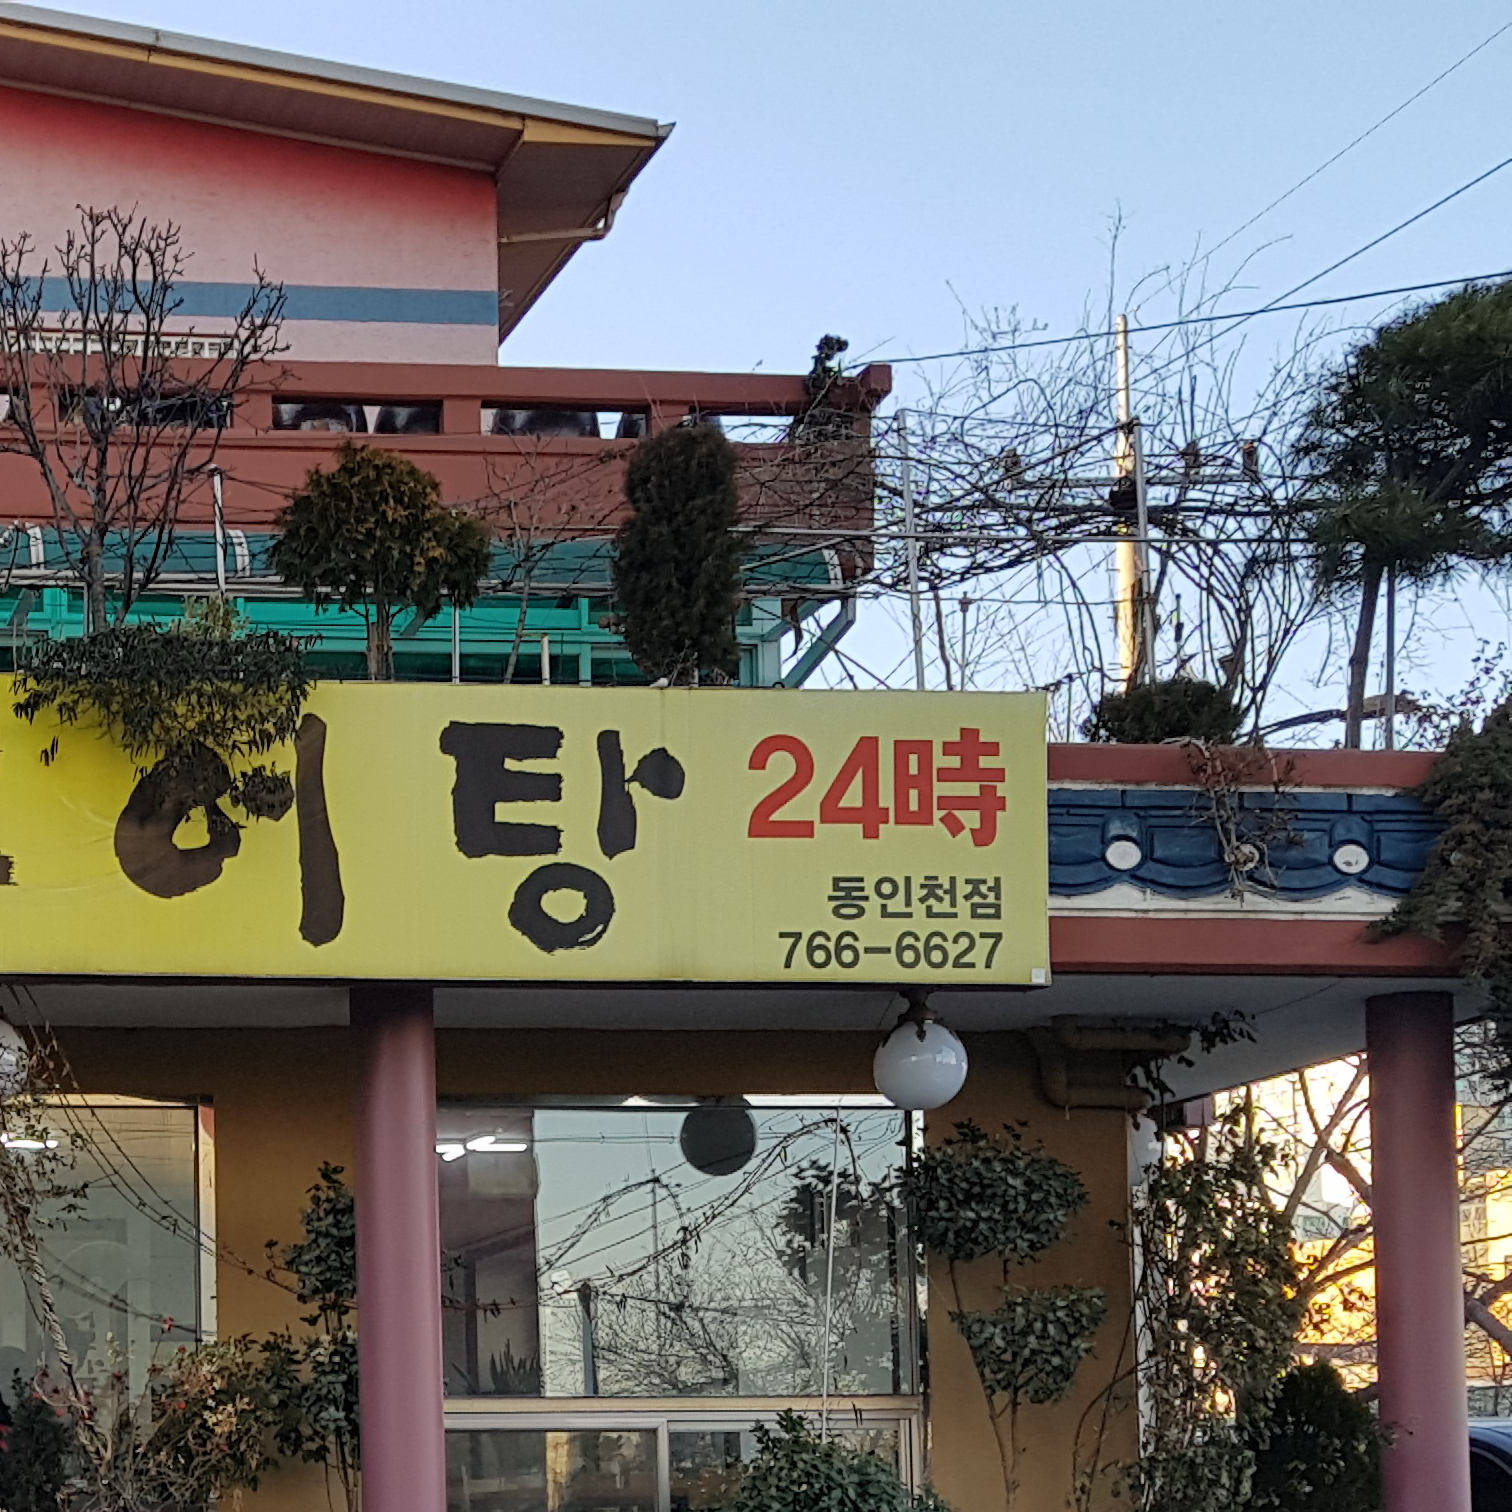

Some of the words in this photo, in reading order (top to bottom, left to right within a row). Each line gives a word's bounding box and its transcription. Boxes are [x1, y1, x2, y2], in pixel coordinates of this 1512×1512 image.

[747, 727, 1007, 848] 24時
[826, 875, 1003, 921] 동인천점
[777, 930, 1004, 970] 766-6627
